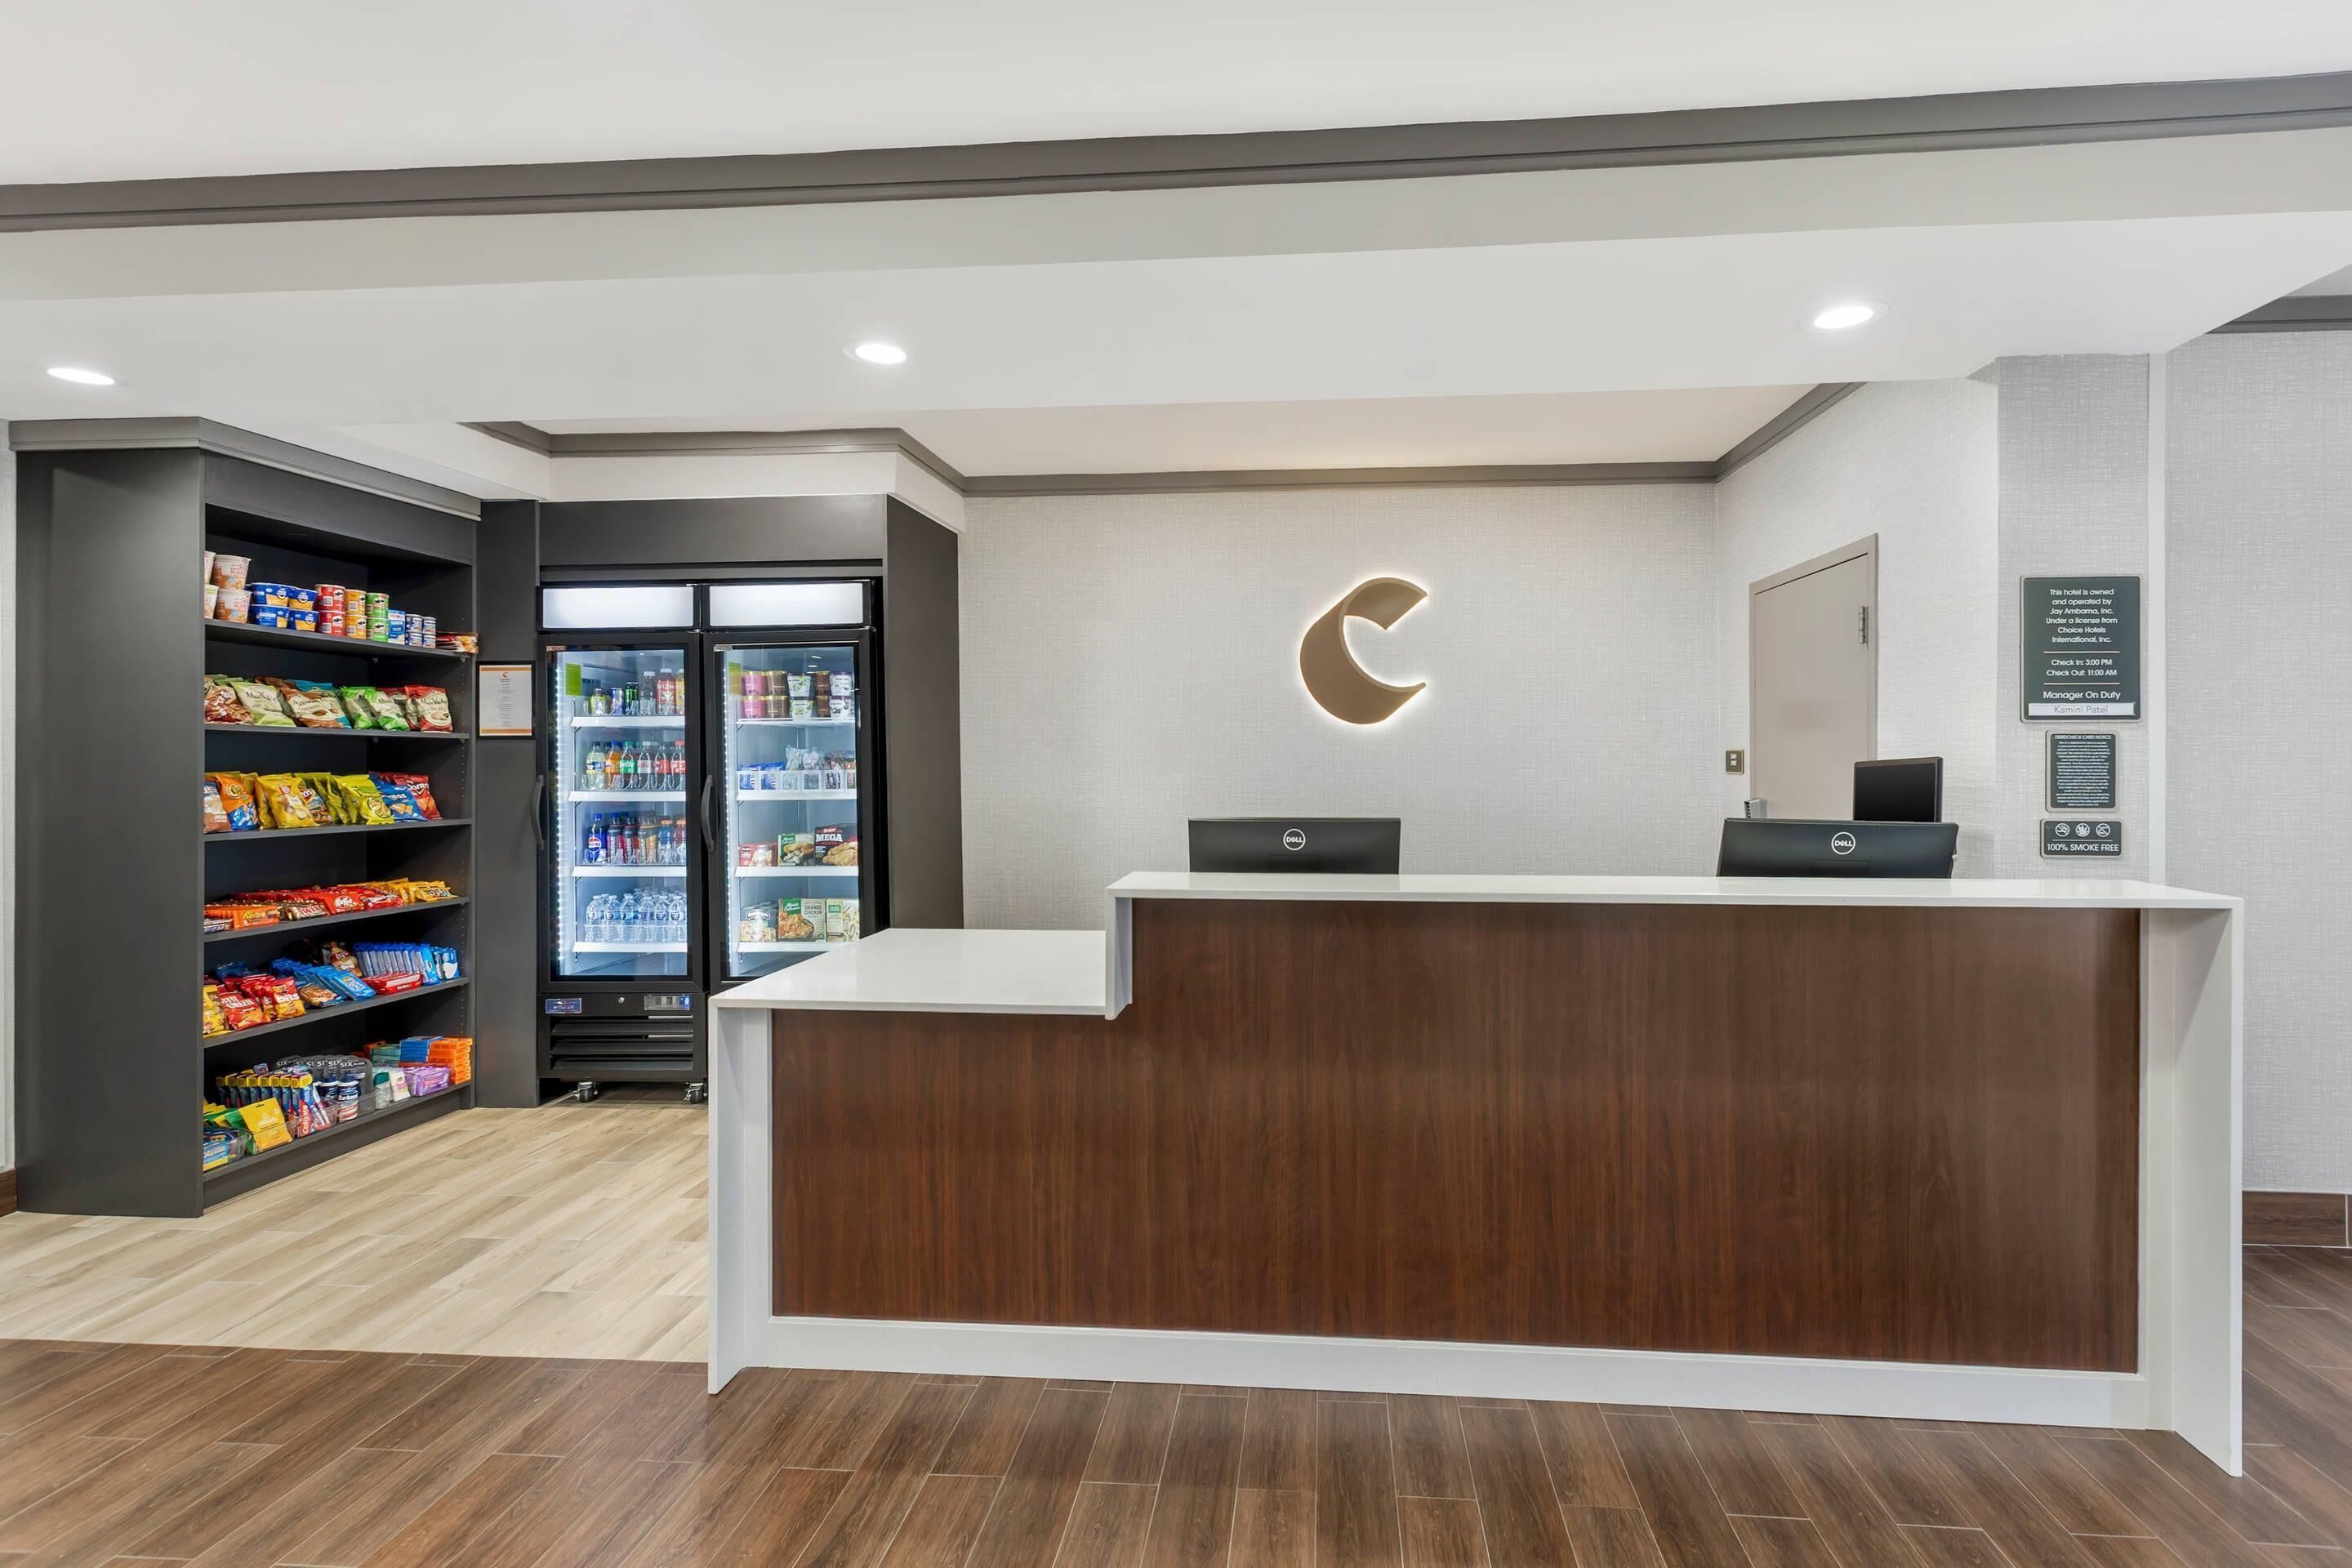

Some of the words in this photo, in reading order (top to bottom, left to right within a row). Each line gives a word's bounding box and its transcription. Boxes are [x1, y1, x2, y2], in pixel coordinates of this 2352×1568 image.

[2043, 691, 2083, 701] Manager
[2085, 691, 2099, 699] On
[2100, 691, 2121, 700] Duty
[2054, 706, 2083, 714] Kamini
[2086, 706, 2109, 714] Patel
[816, 833, 843, 842] MEGA
[2100, 844, 2120, 852] FREE
[301, 1105, 310, 1134] Colgate
